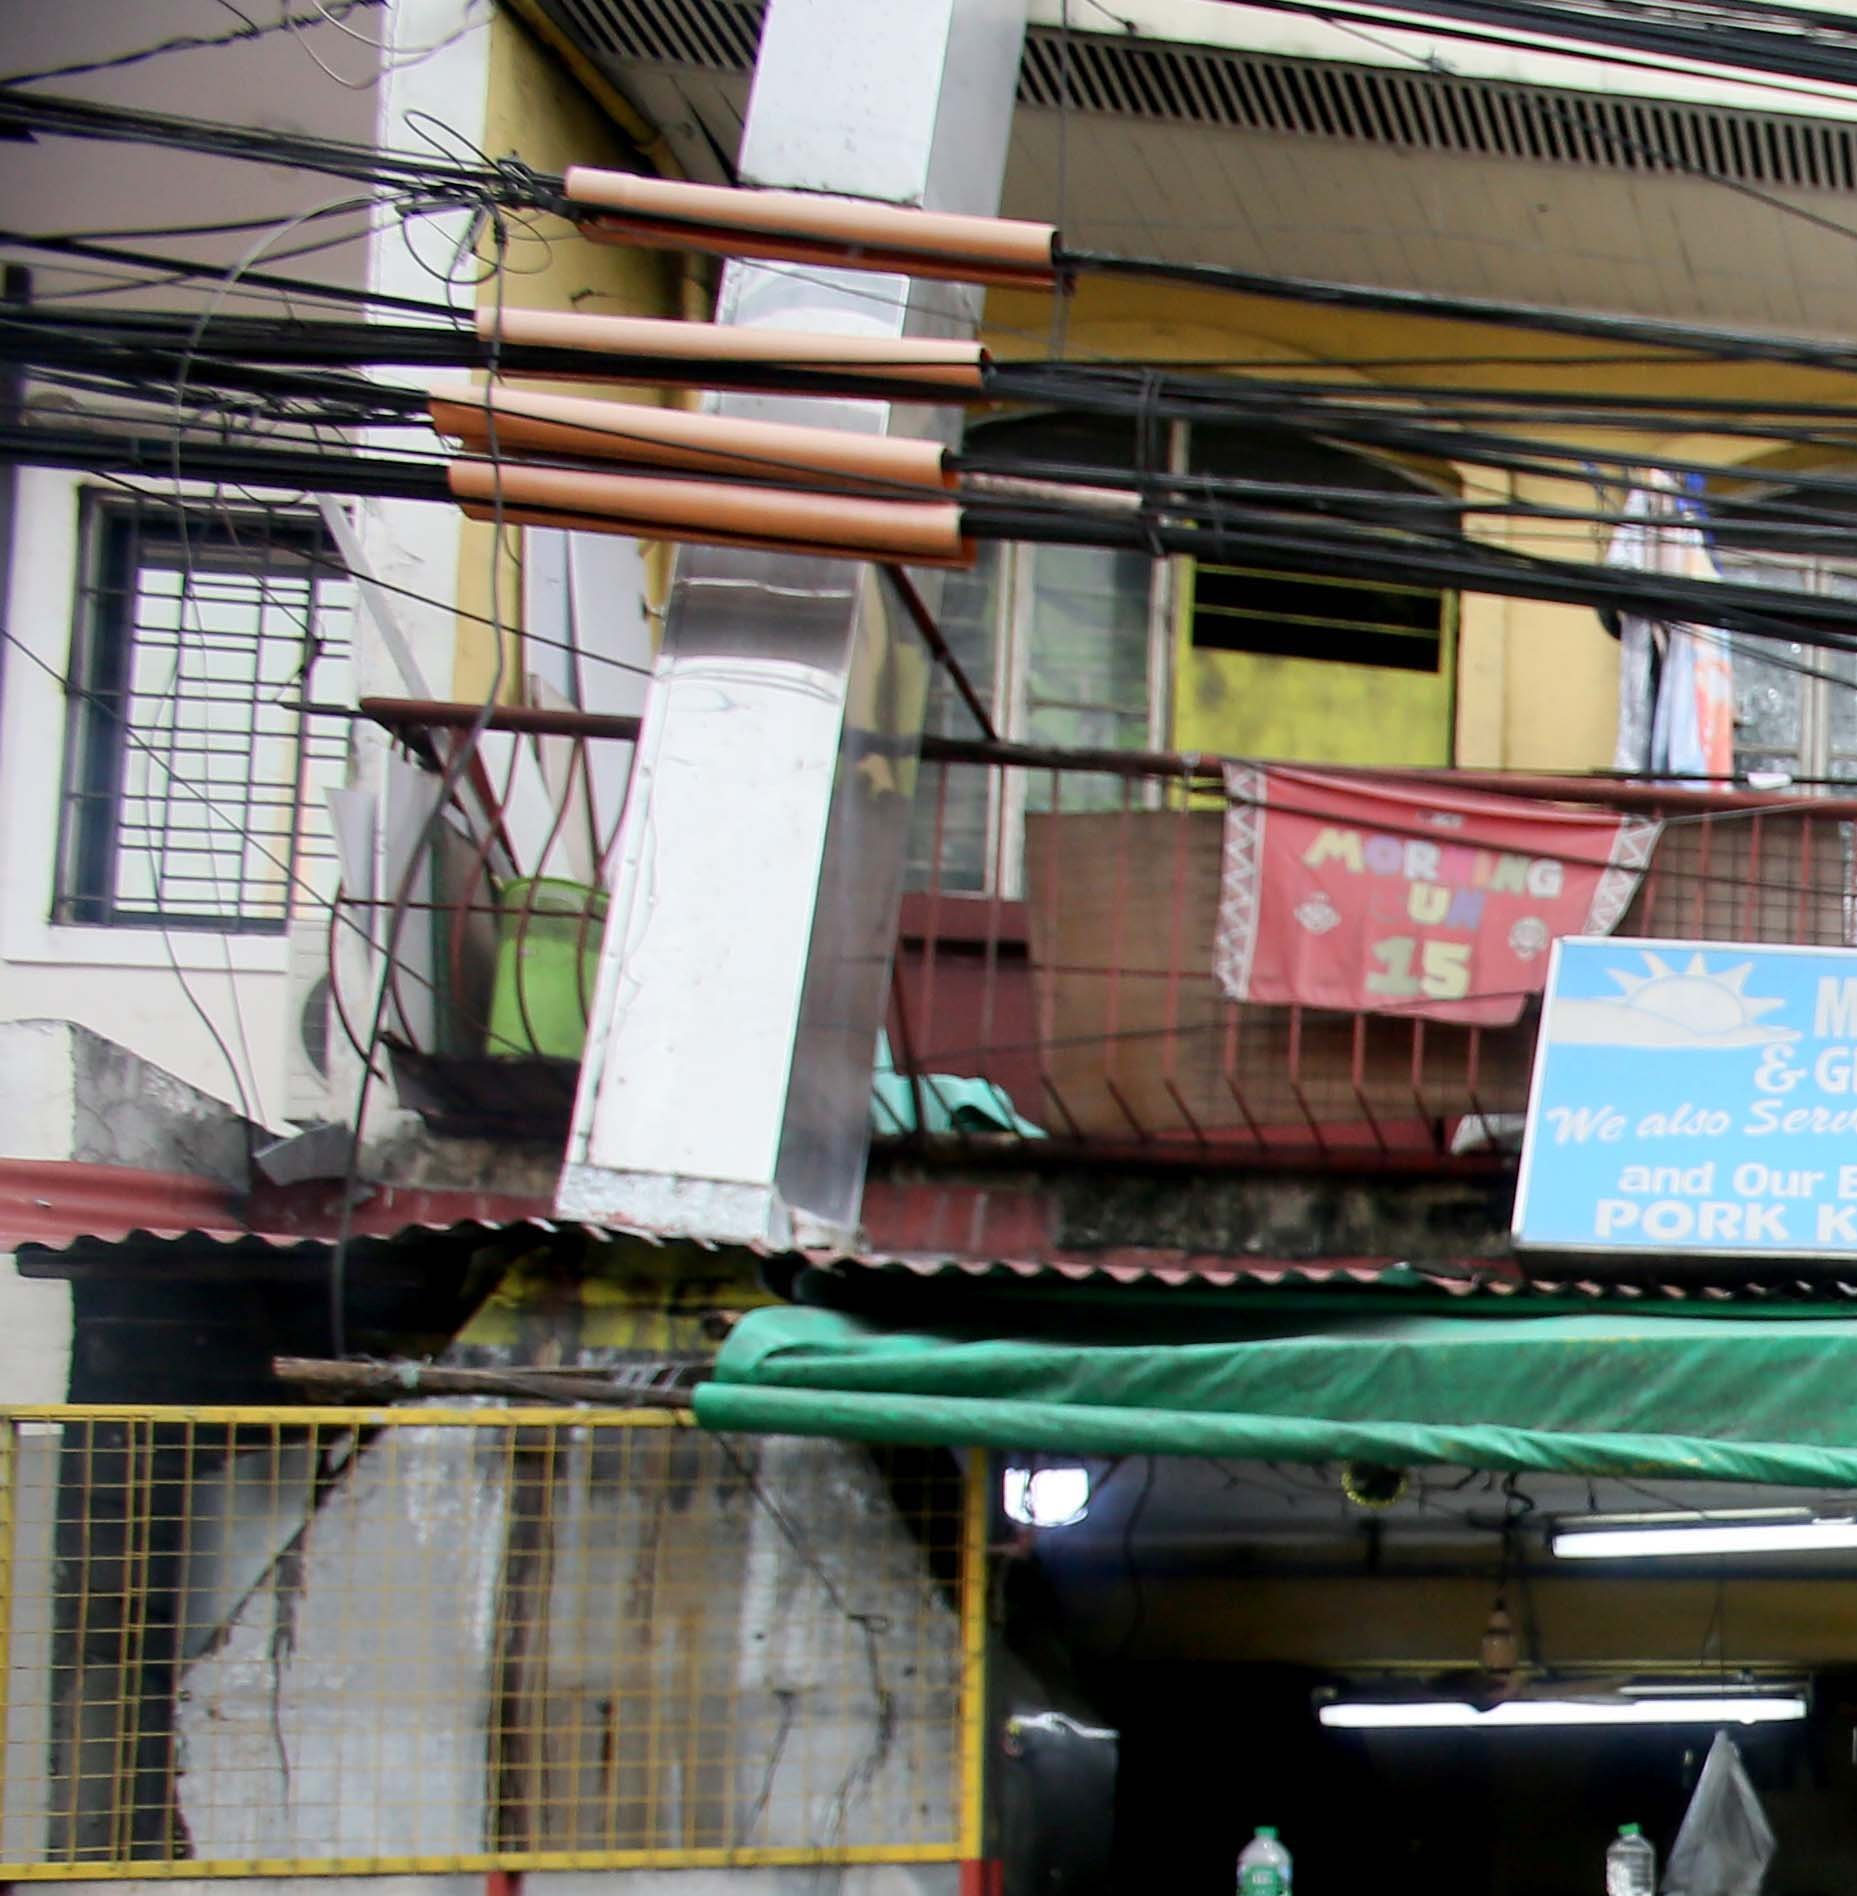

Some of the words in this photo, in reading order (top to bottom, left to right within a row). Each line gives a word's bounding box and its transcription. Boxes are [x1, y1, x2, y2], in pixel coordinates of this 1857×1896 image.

[1303, 828, 1564, 898] MORNING
[1365, 936, 1471, 1000] 15
[1754, 1043, 1806, 1093] &
[1545, 1103, 1627, 1147] We
[1637, 1102, 1730, 1138] also
[1618, 1161, 1716, 1195] and
[1733, 1162, 1825, 1199] Our
[1593, 1199, 1790, 1242] PORK
